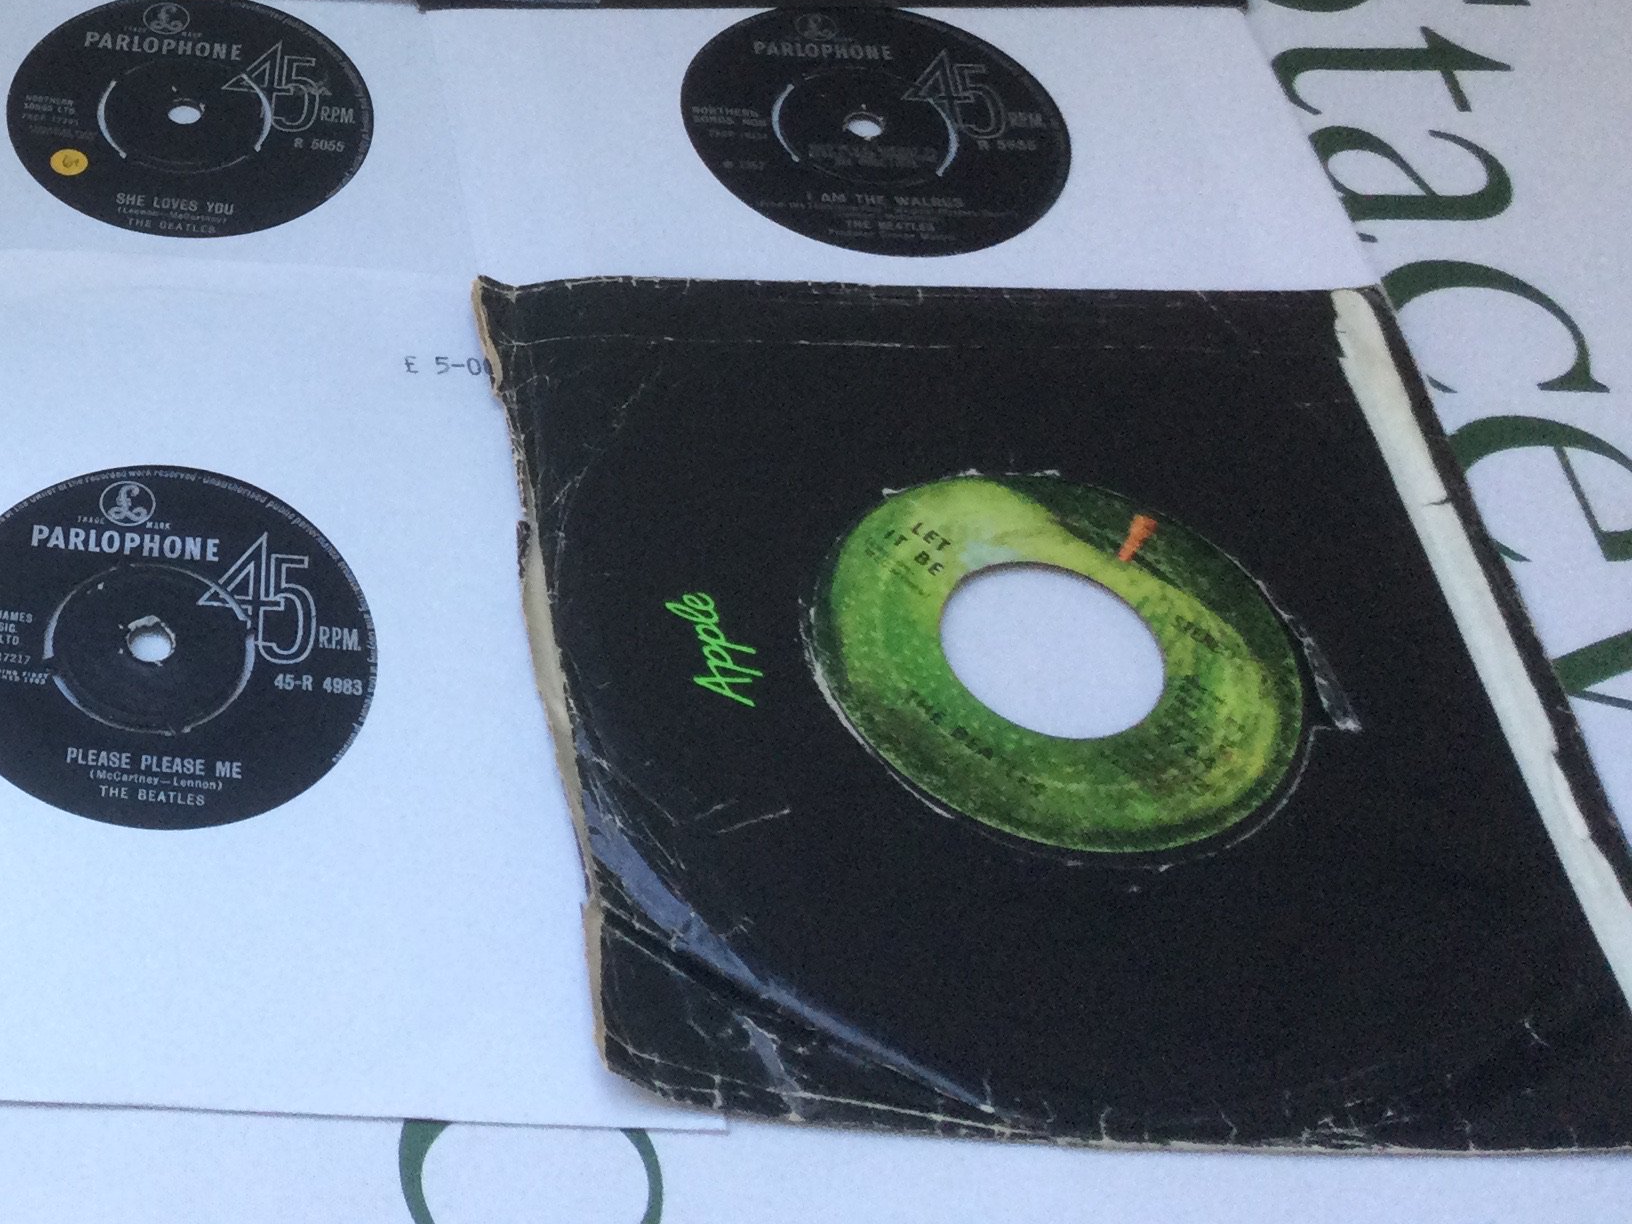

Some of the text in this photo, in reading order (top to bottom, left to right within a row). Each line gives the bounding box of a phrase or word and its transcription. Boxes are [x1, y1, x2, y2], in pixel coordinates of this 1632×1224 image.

[84, 31, 242, 61] PARLOPHONE
[752, 40, 894, 61] PARLOPHONE
[221, 40, 320, 132] 45
[900, 48, 1006, 139] 45
[293, 137, 346, 153] R 5055
[115, 192, 235, 216] SHE LOVES YOU
[821, 191, 847, 203] AM
[855, 193, 886, 206] THE
[893, 195, 965, 209] WALRUS
[128, 217, 217, 234] THE BEATLES
[31, 524, 221, 563] PARLOPHONE
[911, 522, 952, 551] LET
[883, 529, 945, 577] IT BE
[196, 531, 317, 665] 45
[318, 625, 363, 652] R.P.M.
[665, 592, 764, 707] Apple
[274, 673, 364, 697] 45-R 4983
[66, 747, 243, 779] PLEASE PLEASE ME
[99, 785, 206, 807] THE BEATLES
